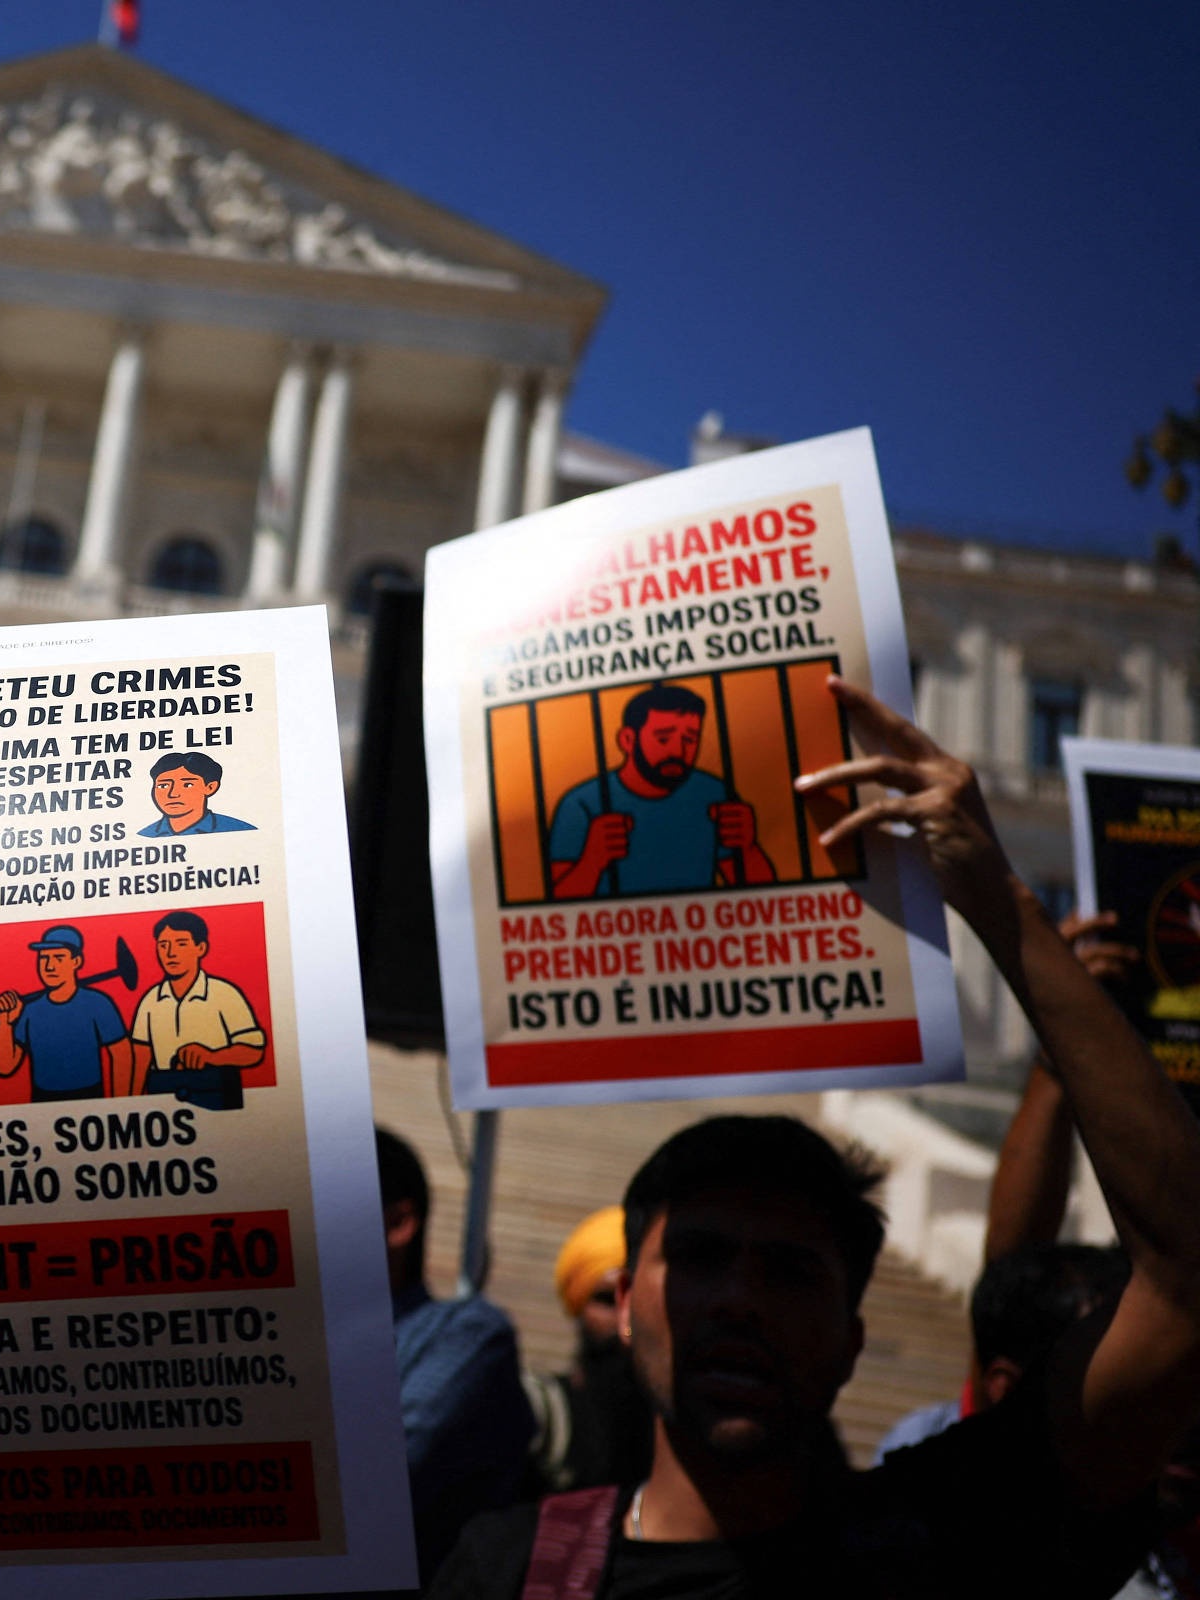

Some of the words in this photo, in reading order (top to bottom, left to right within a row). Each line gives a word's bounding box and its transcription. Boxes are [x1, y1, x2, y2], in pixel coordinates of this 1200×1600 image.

[528, 543, 831, 628] NESTAMENTE,
[645, 586, 822, 638] IMPOSTOS
[90, 664, 242, 695] CRIMES
[482, 673, 498, 698] E
[507, 639, 695, 692] SEGURANÇA
[704, 621, 836, 660] SOCIAL.
[28, 705, 64, 726] DE
[74, 693, 254, 723] LIBERDADE!
[71, 733, 129, 755] TEM
[139, 730, 174, 751] DE
[186, 726, 233, 747] LEI
[51, 825, 83, 846] NO
[89, 822, 126, 842] SIS
[83, 844, 187, 871] IMPEDIR
[83, 877, 110, 898] DE
[118, 865, 261, 896] RESIDÊNCIA!
[501, 913, 567, 945] MAS
[575, 905, 679, 940] AGORA
[685, 903, 706, 931] O
[714, 891, 864, 928] GOVERNO
[504, 940, 645, 983] PRENDE
[654, 925, 875, 974] INOCENTES.
[509, 988, 600, 1031] ISTO
[614, 979, 638, 1024] É
[650, 969, 886, 1021] INJUSTIÇA!
[53, 1108, 197, 1153] SOMOS
[74, 1156, 218, 1201] SOMOS
[88, 1219, 279, 1286] PRISÃO
[31, 1316, 54, 1351] E
[67, 1306, 279, 1349] RESPEITO:
[83, 1352, 298, 1393] CONTRIBUÍMOS,
[40, 1397, 243, 1434] DOCUMENTOS
[61, 1464, 156, 1499] PARA
[165, 1456, 294, 1496] TODOS!
